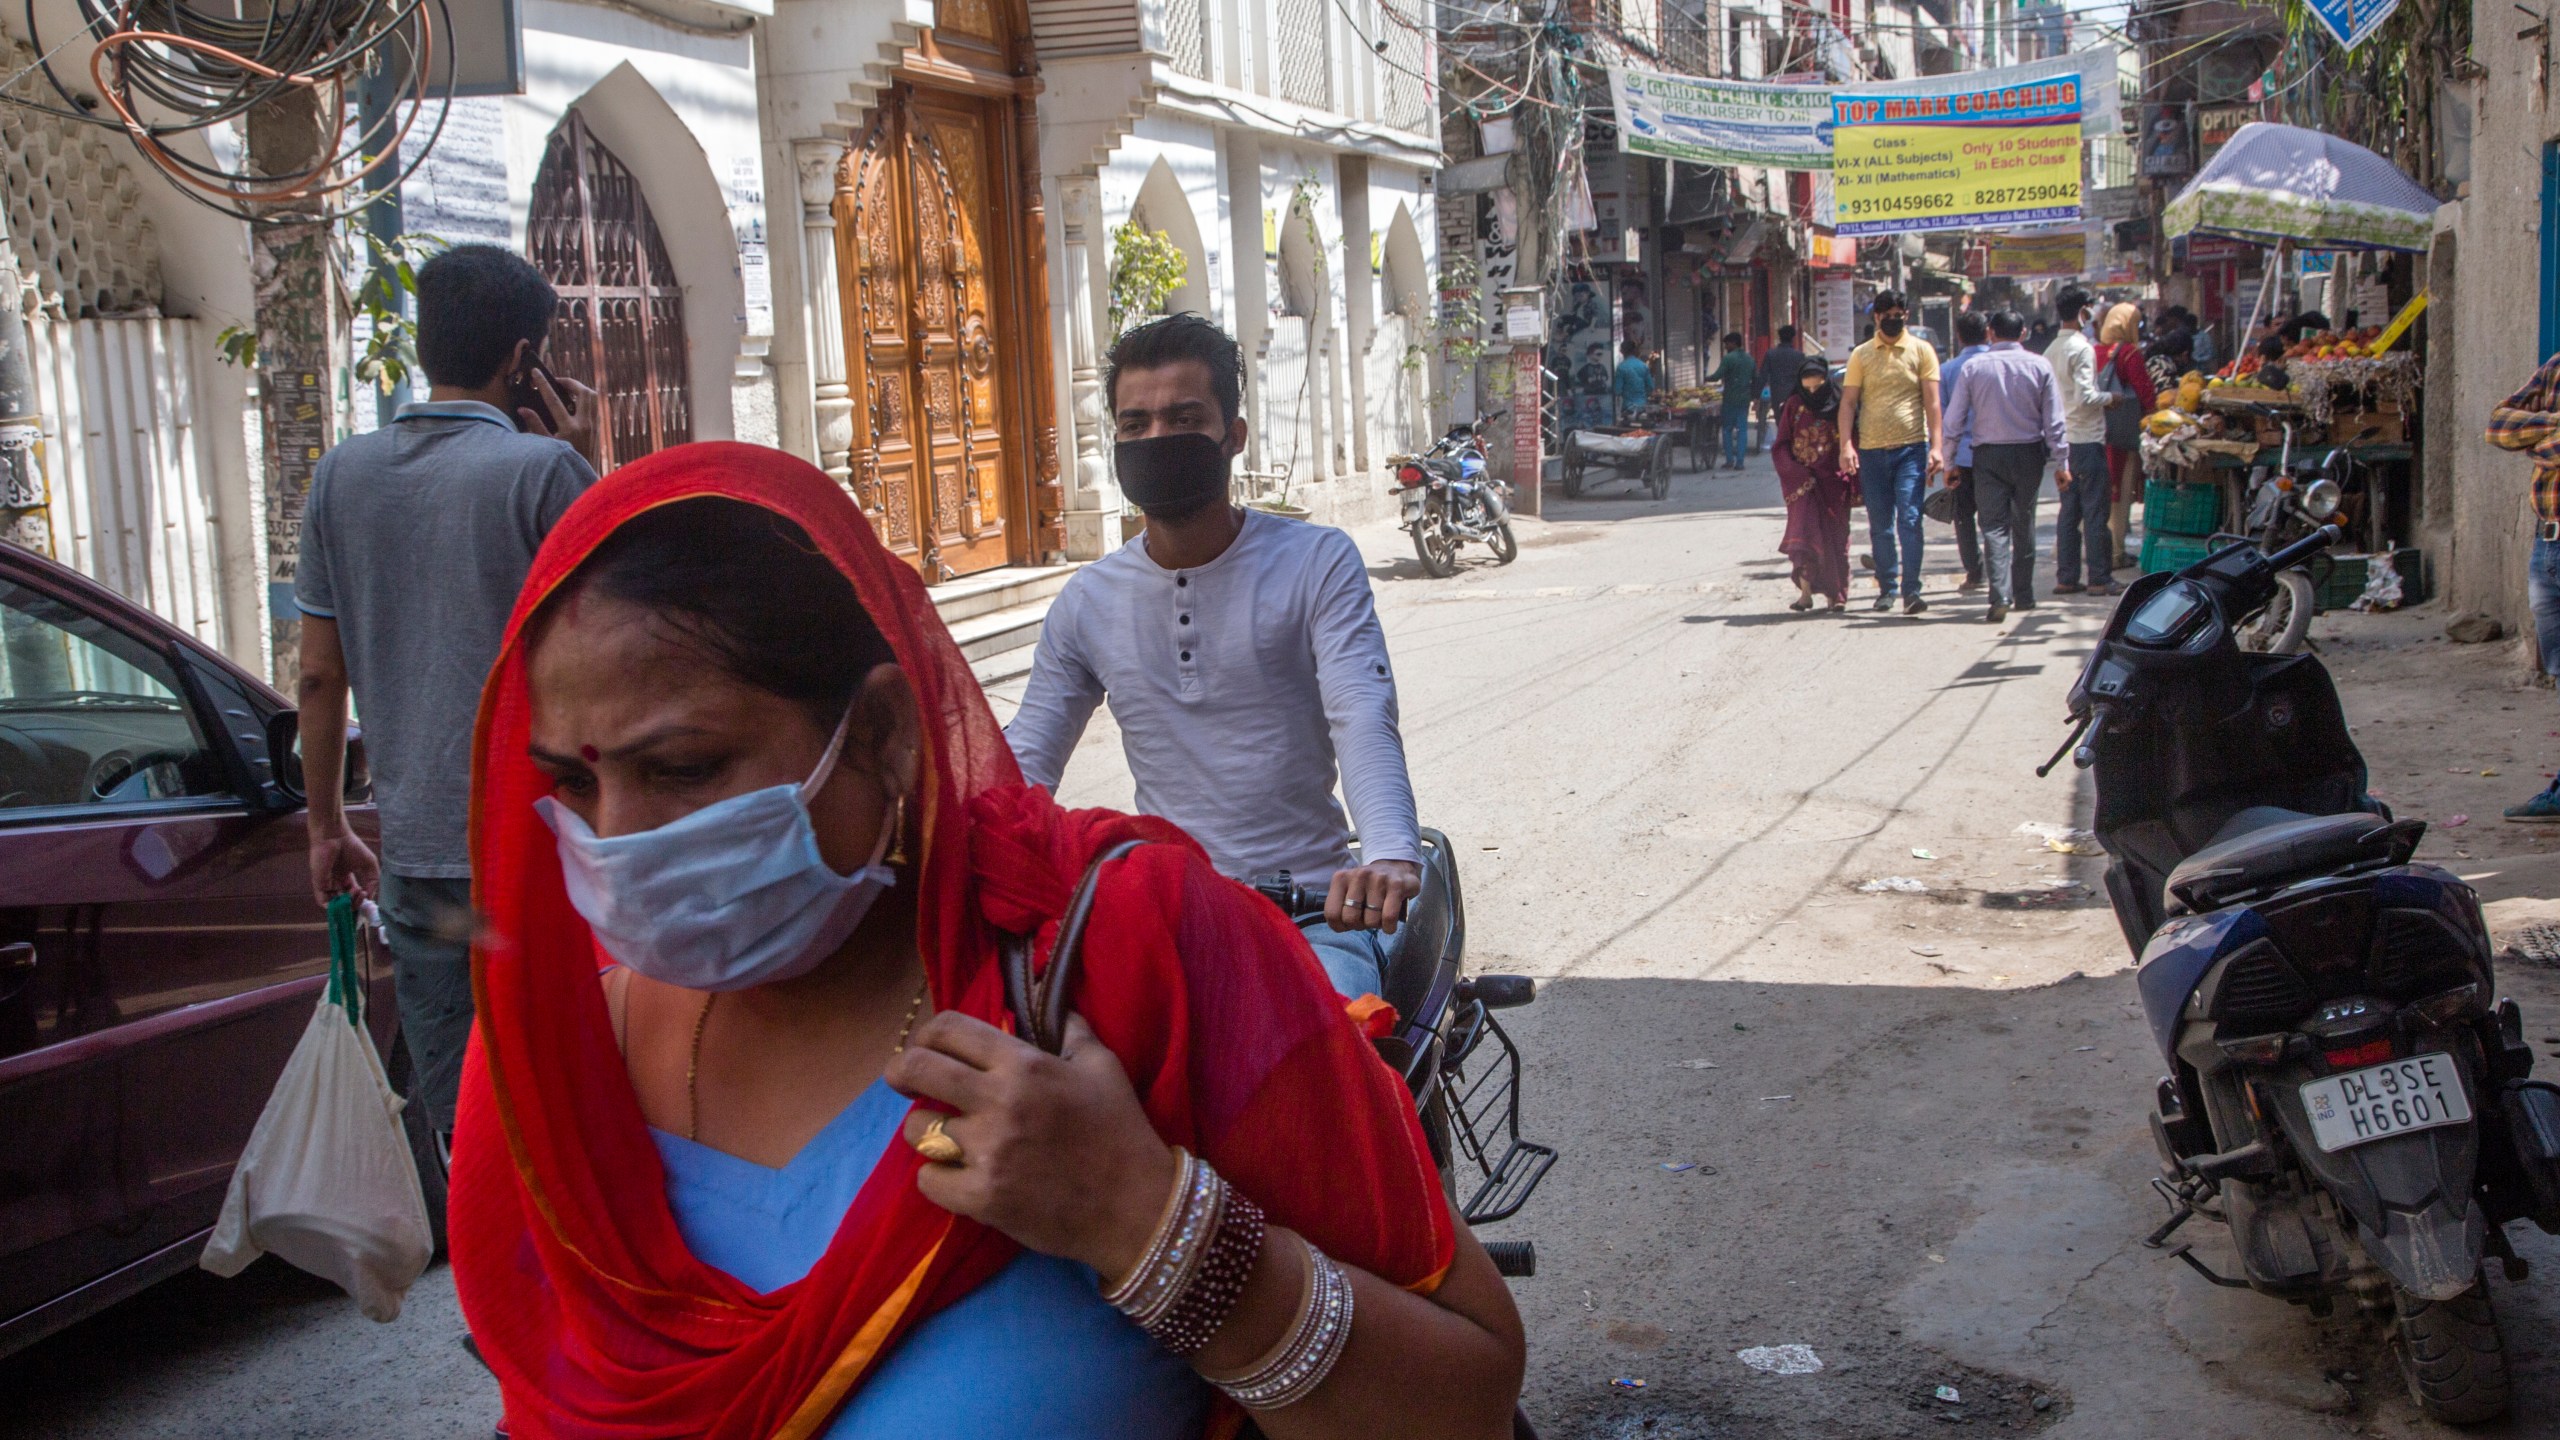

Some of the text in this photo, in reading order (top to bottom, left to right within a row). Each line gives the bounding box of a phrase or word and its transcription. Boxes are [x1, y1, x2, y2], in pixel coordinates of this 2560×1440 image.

[1650, 80, 1713, 101] GARDEN
[1718, 88, 1777, 106] PUBLIC
[1837, 83, 2077, 122] TOP MARK COACHING
[1661, 98, 1763, 122] (PRE-NURSERY
[1768, 109, 1786, 122] TO
[2201, 108, 2258, 130] OPTICS
[1873, 137, 1906, 149] Class
[1962, 135, 2078, 157] Only 10 Students
[1837, 156, 1861, 168] VI-X
[1864, 154, 1891, 168] (ALL
[1896, 150, 1954, 168] Subjects)
[1974, 154, 2066, 170] in Each Class
[1857, 173, 1872, 185] XII
[1875, 167, 1960, 185] (Mathematics)
[1851, 192, 1954, 214] 9310459662
[1975, 183, 2079, 205] 8287259042
[2323, 1001, 2366, 1020] TVS
[2339, 1059, 2441, 1106] DL3SE
[2317, 1110, 2335, 1121] IND
[2349, 1091, 2450, 1137] H6601
